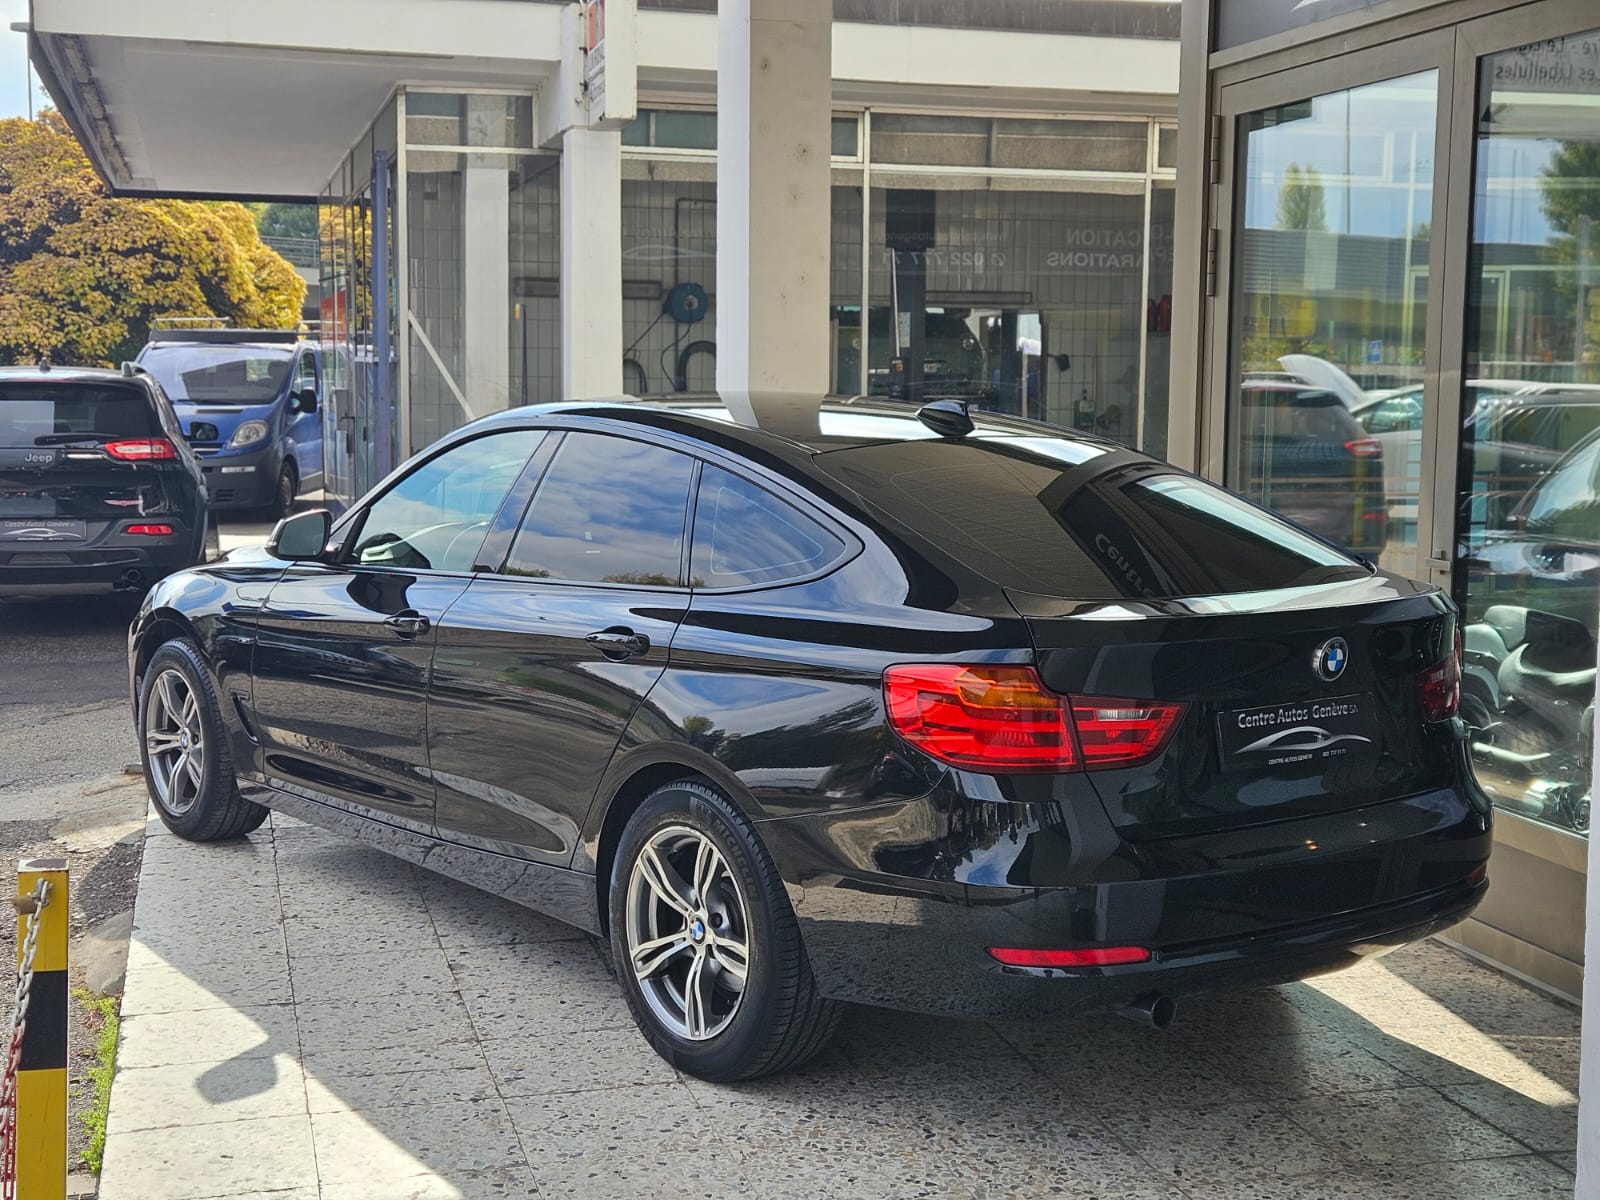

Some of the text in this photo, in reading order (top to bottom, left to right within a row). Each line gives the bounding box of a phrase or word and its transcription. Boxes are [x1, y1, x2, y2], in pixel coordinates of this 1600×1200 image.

[24, 451, 53, 464] Jeep
[1237, 712, 1276, 729] Centre
[1276, 708, 1309, 724] Autos
[1311, 702, 1349, 719] Genève
